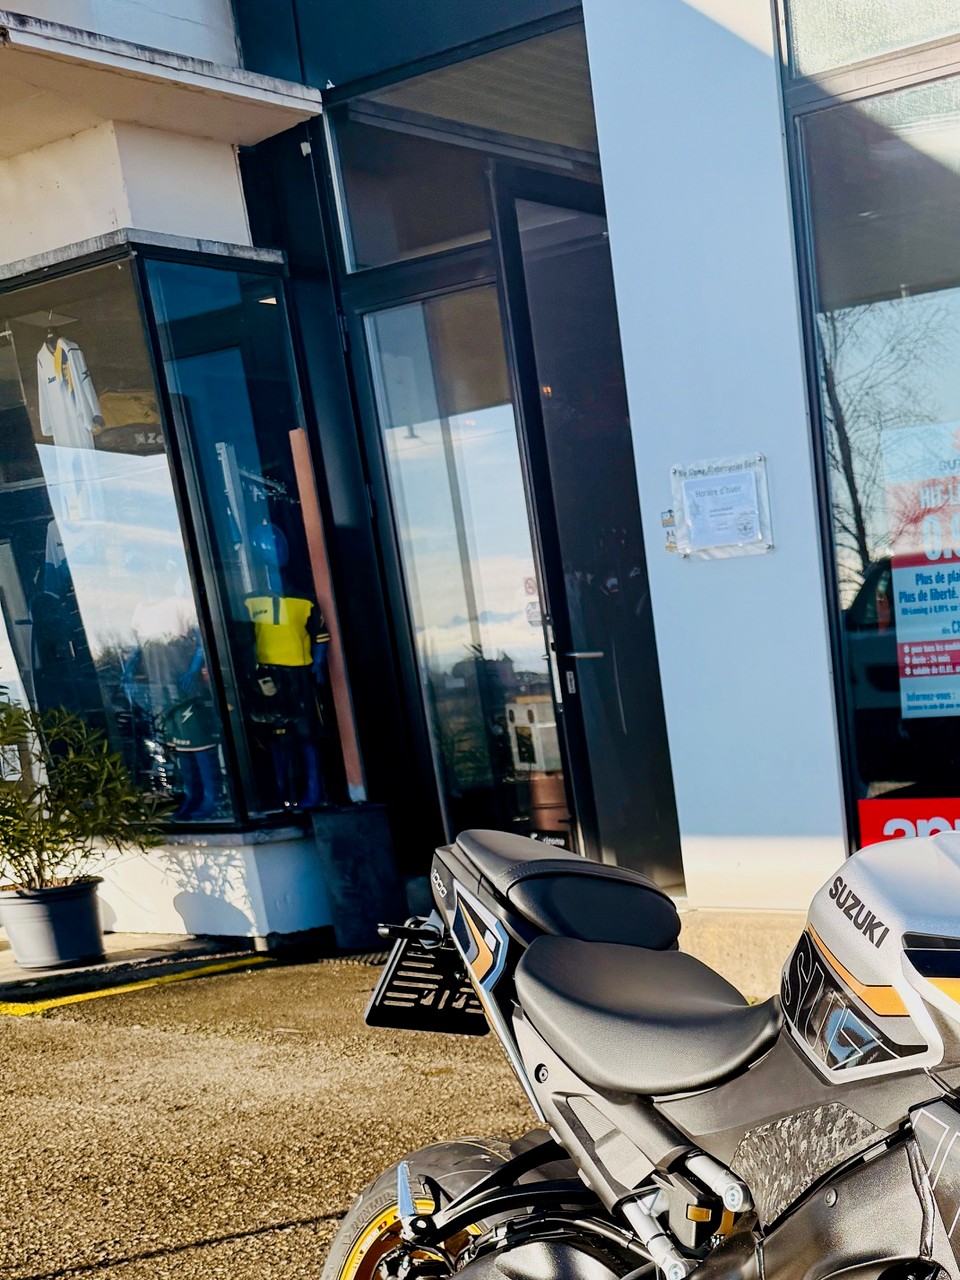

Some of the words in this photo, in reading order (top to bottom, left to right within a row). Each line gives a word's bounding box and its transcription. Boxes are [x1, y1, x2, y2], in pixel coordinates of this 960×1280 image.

[915, 573, 933, 586] Plus
[935, 572, 945, 584] de
[898, 591, 916, 604] Plus
[918, 589, 928, 602] de
[930, 586, 959, 601] liberté.
[828, 876, 890, 949] SUZUKI
